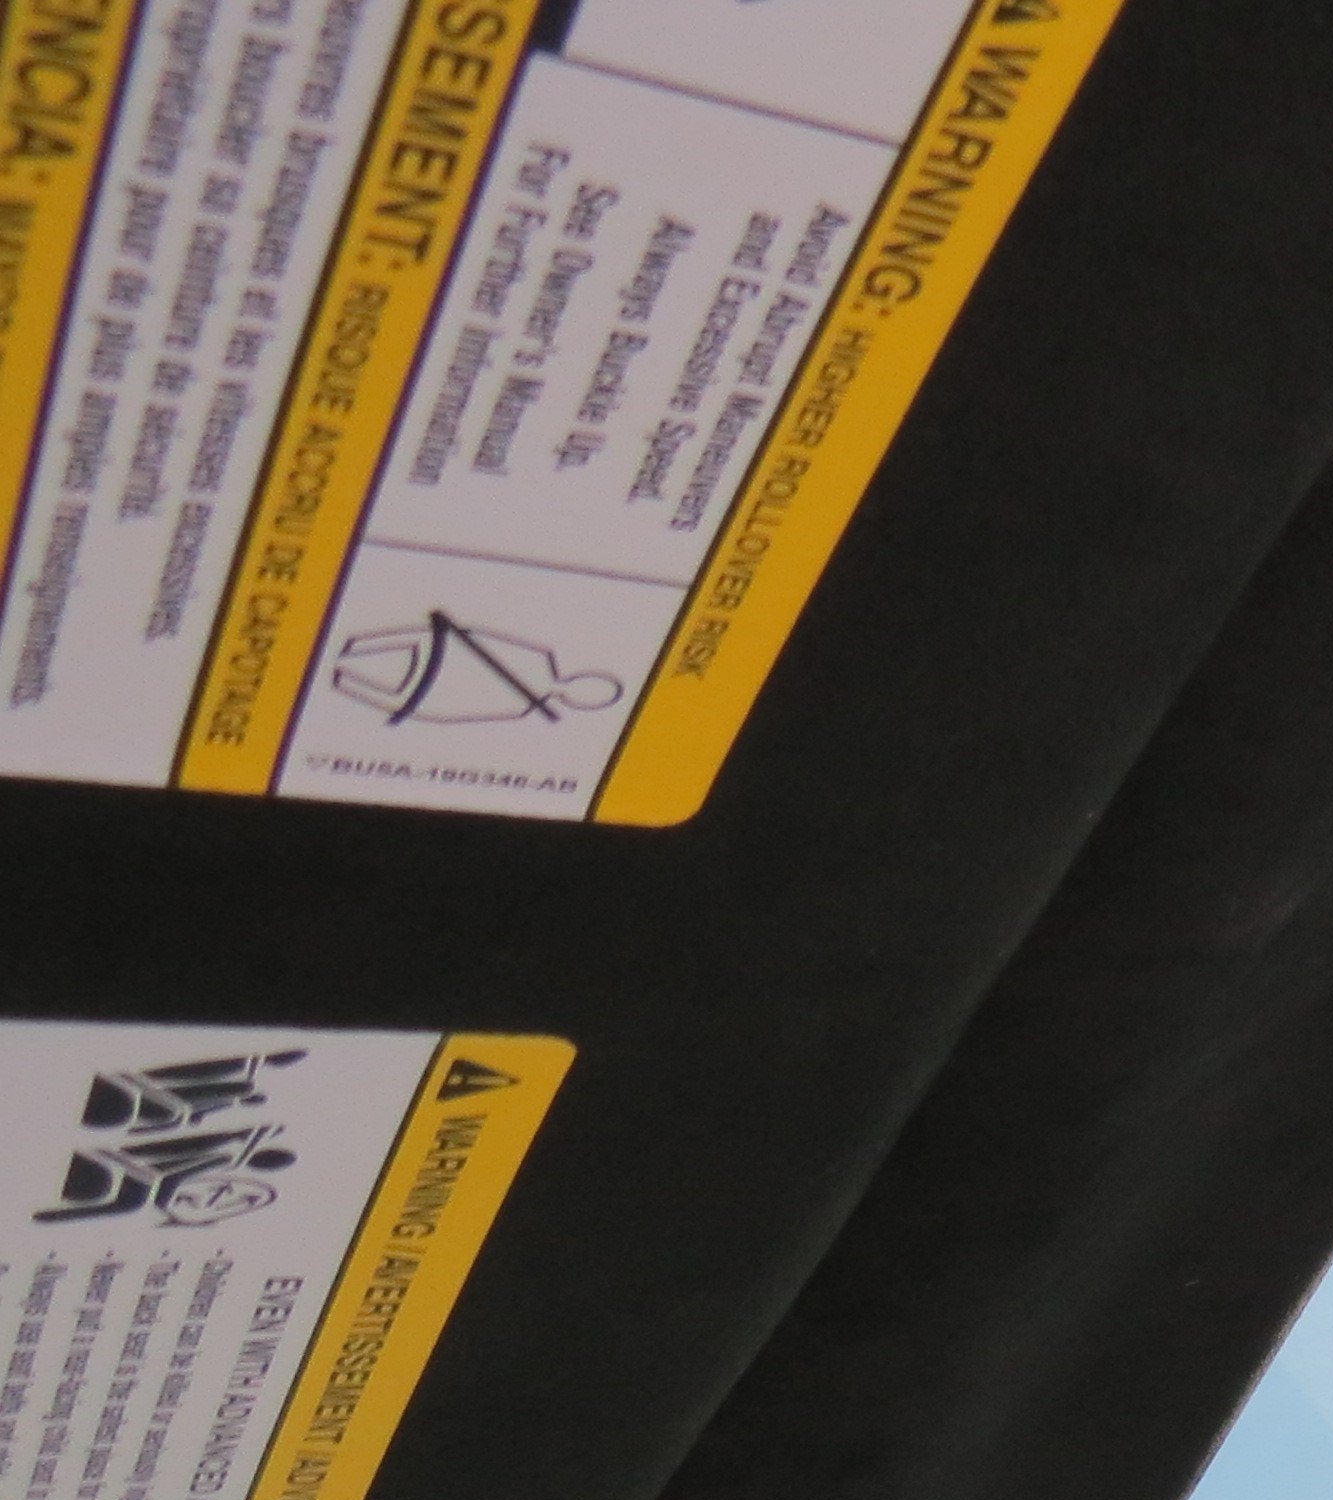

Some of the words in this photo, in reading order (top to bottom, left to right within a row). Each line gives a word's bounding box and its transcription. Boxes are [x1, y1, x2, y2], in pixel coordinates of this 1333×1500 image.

[367, 0, 508, 266] SEMENT:
[516, 142, 571, 199] For
[854, 46, 1040, 314] WARNING:
[471, 206, 548, 318] Further
[563, 183, 619, 240] See
[731, 212, 780, 271] and
[785, 203, 850, 286] Avoid
[513, 248, 594, 367] Owner's
[619, 216, 695, 322] Always
[309, 284, 389, 413] RISQUE
[577, 330, 648, 424] Buckle
[668, 276, 761, 412] Excessive
[738, 291, 810, 386] Abrupt
[788, 327, 870, 449] HIGHER
[409, 324, 501, 485] Information
[473, 375, 544, 475] Manual
[273, 422, 342, 534] ACCRU
[670, 392, 764, 532] Maneuvers
[257, 541, 304, 584] DE
[707, 455, 811, 612] ROLLOVER
[675, 618, 730, 676] RISK
